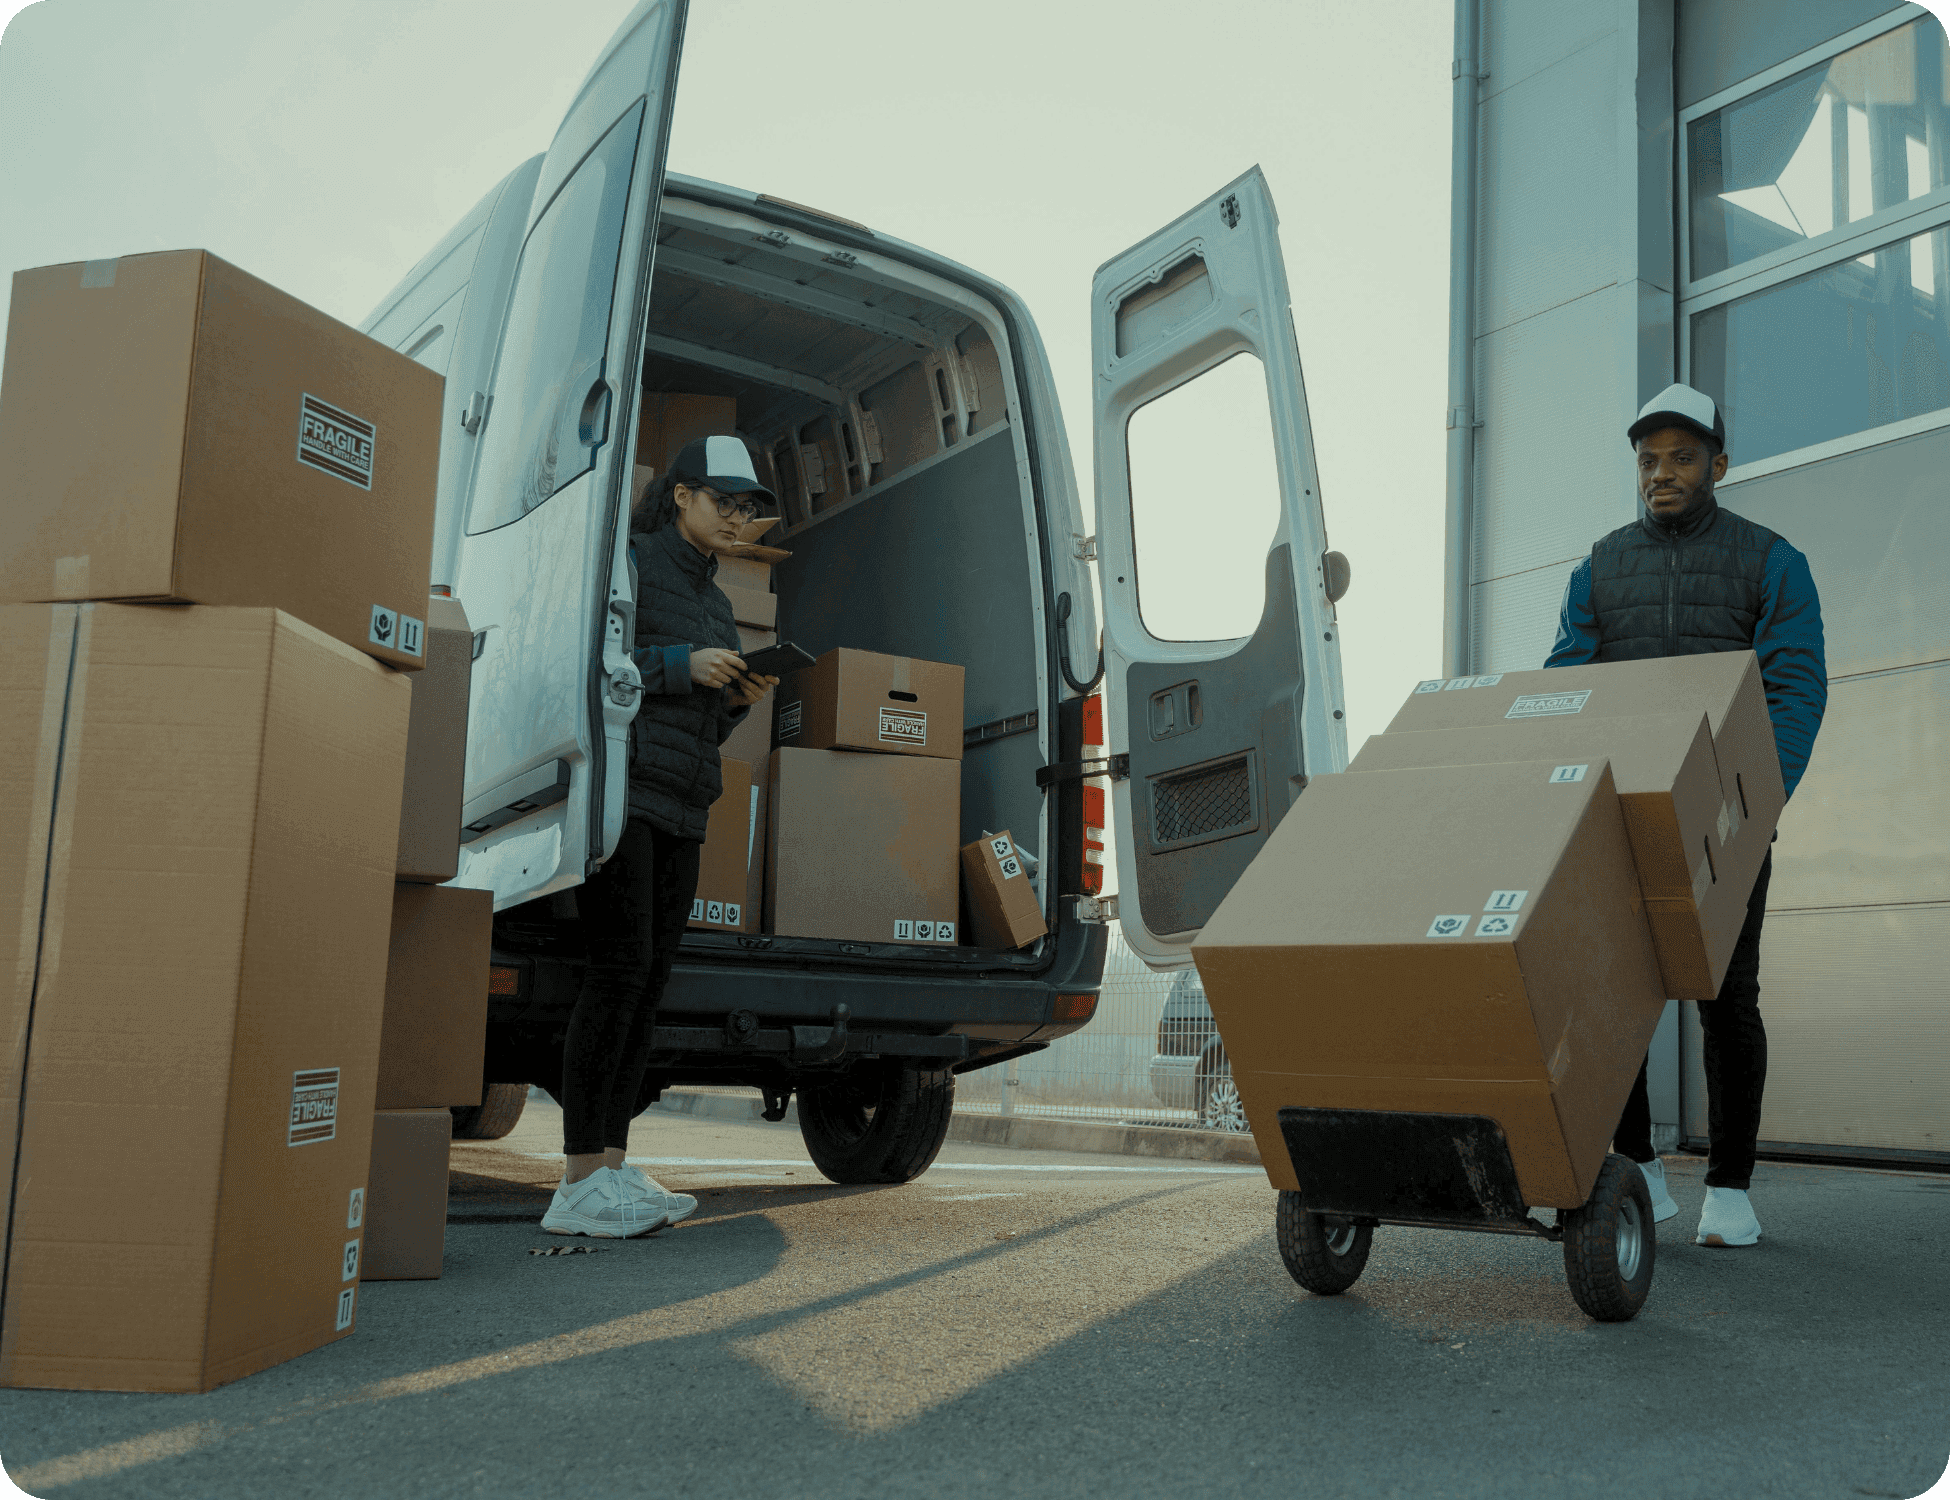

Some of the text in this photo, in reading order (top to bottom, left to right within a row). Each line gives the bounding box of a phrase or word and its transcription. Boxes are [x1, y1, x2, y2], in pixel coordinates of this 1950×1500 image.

[303, 416, 370, 461] FRAGILE
[303, 434, 369, 470] HANDLE WITH CARE
[1514, 698, 1583, 710] FRAGILE
[881, 722, 924, 735] FRAGILE
[293, 1098, 336, 1122] FRAGILE
